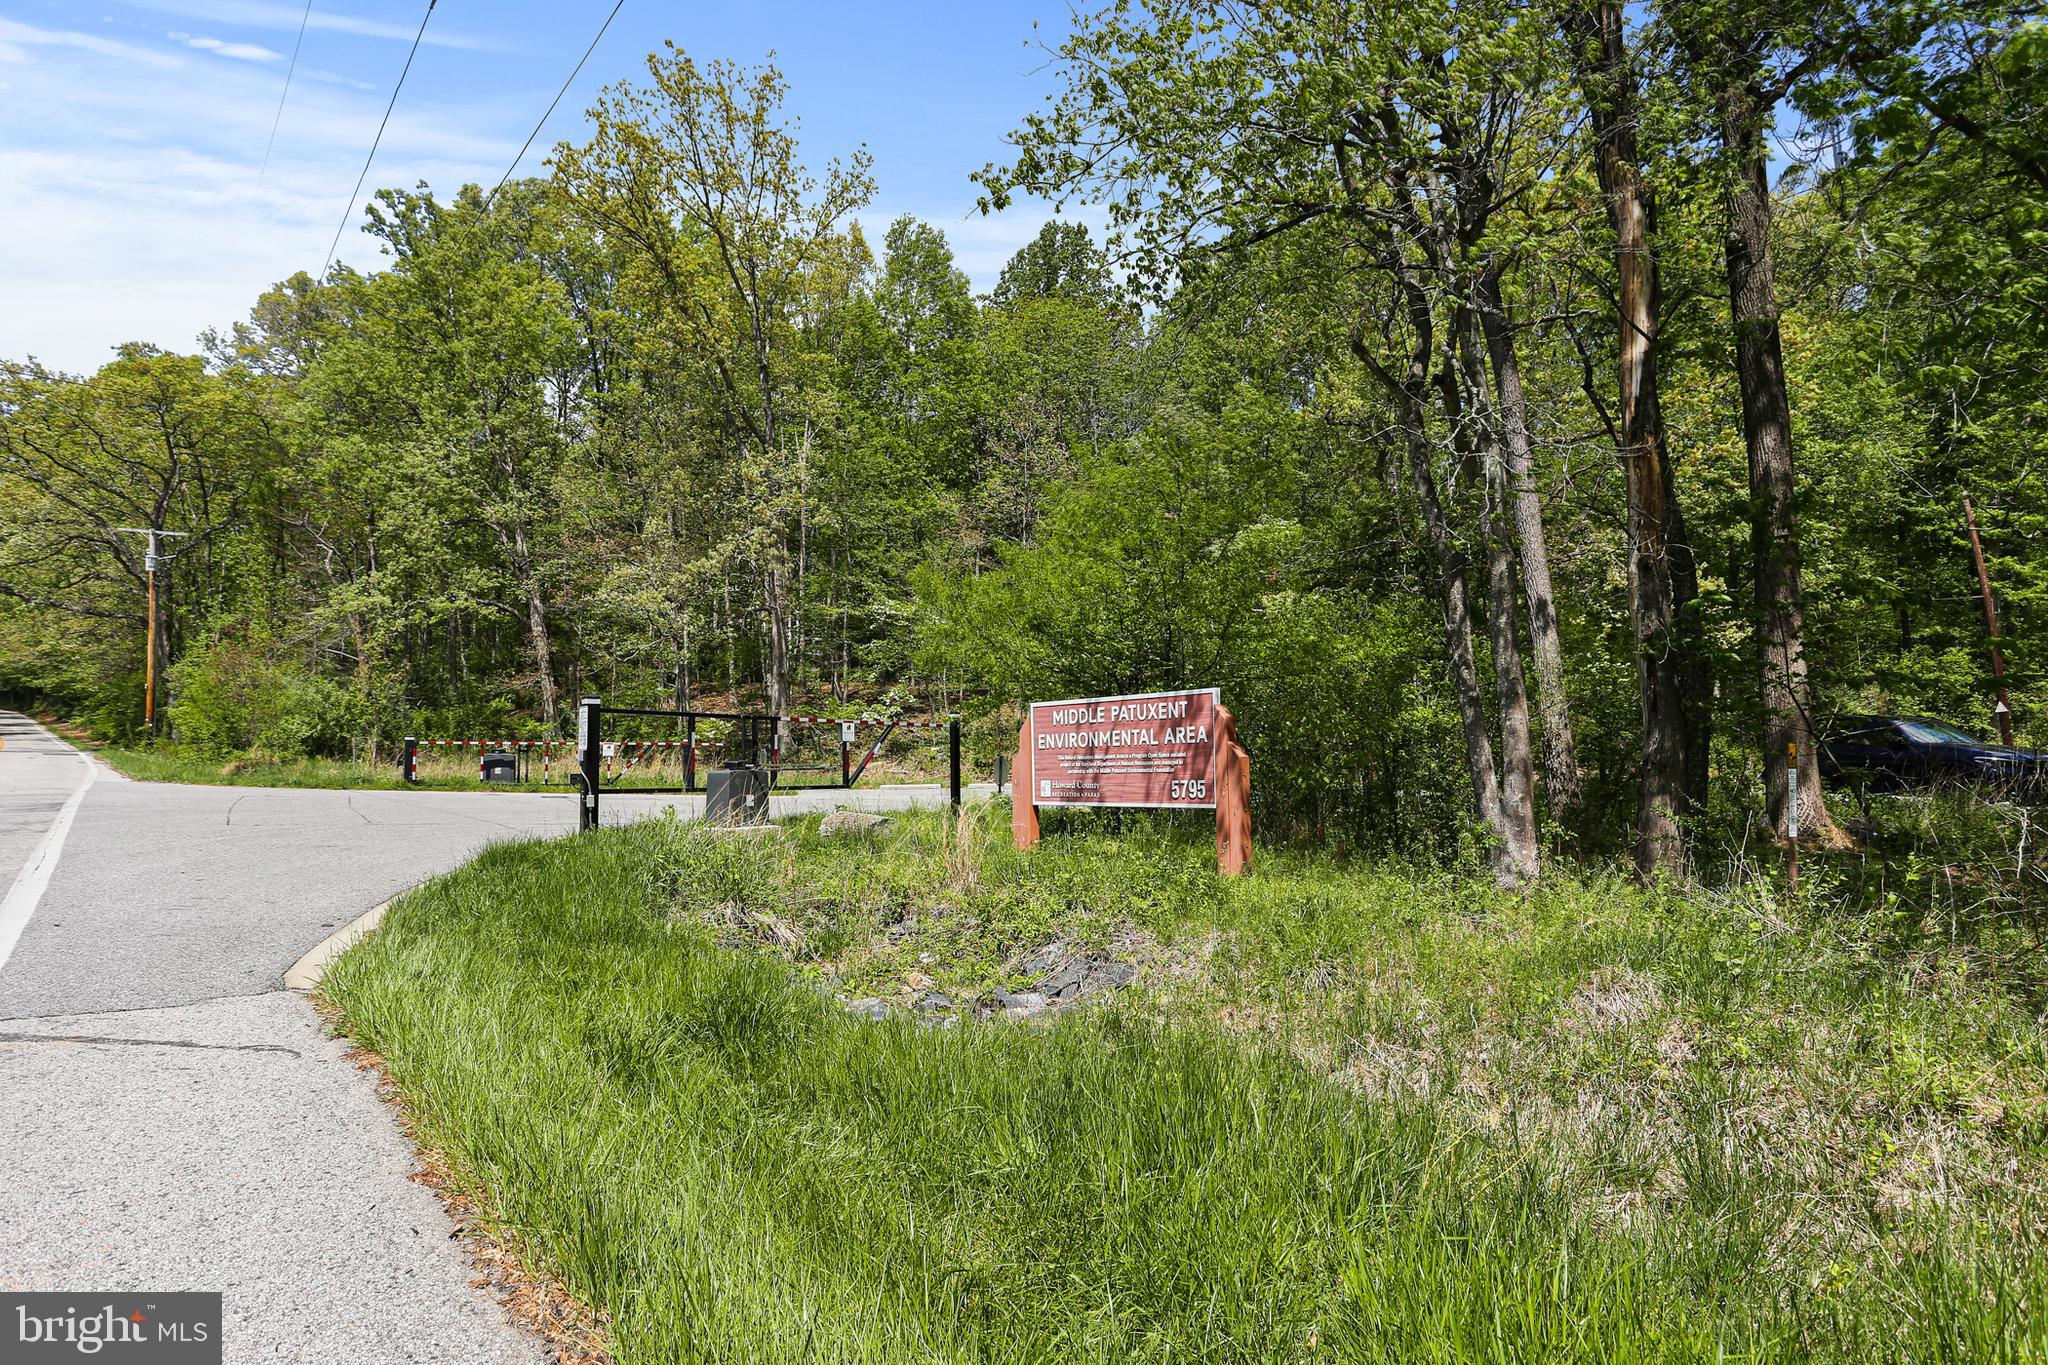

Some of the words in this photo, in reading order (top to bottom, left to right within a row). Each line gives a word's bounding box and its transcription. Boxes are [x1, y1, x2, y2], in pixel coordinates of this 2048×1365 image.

[1053, 707, 1106, 725] MIDDLE
[1111, 700, 1188, 722] PATUXENT
[1038, 730, 1159, 750] ENVIRONMENTAL
[1164, 726, 1208, 744] AREA
[1052, 780, 1075, 789] Howard
[1076, 780, 1101, 791] County
[1171, 779, 1206, 800] 5795
